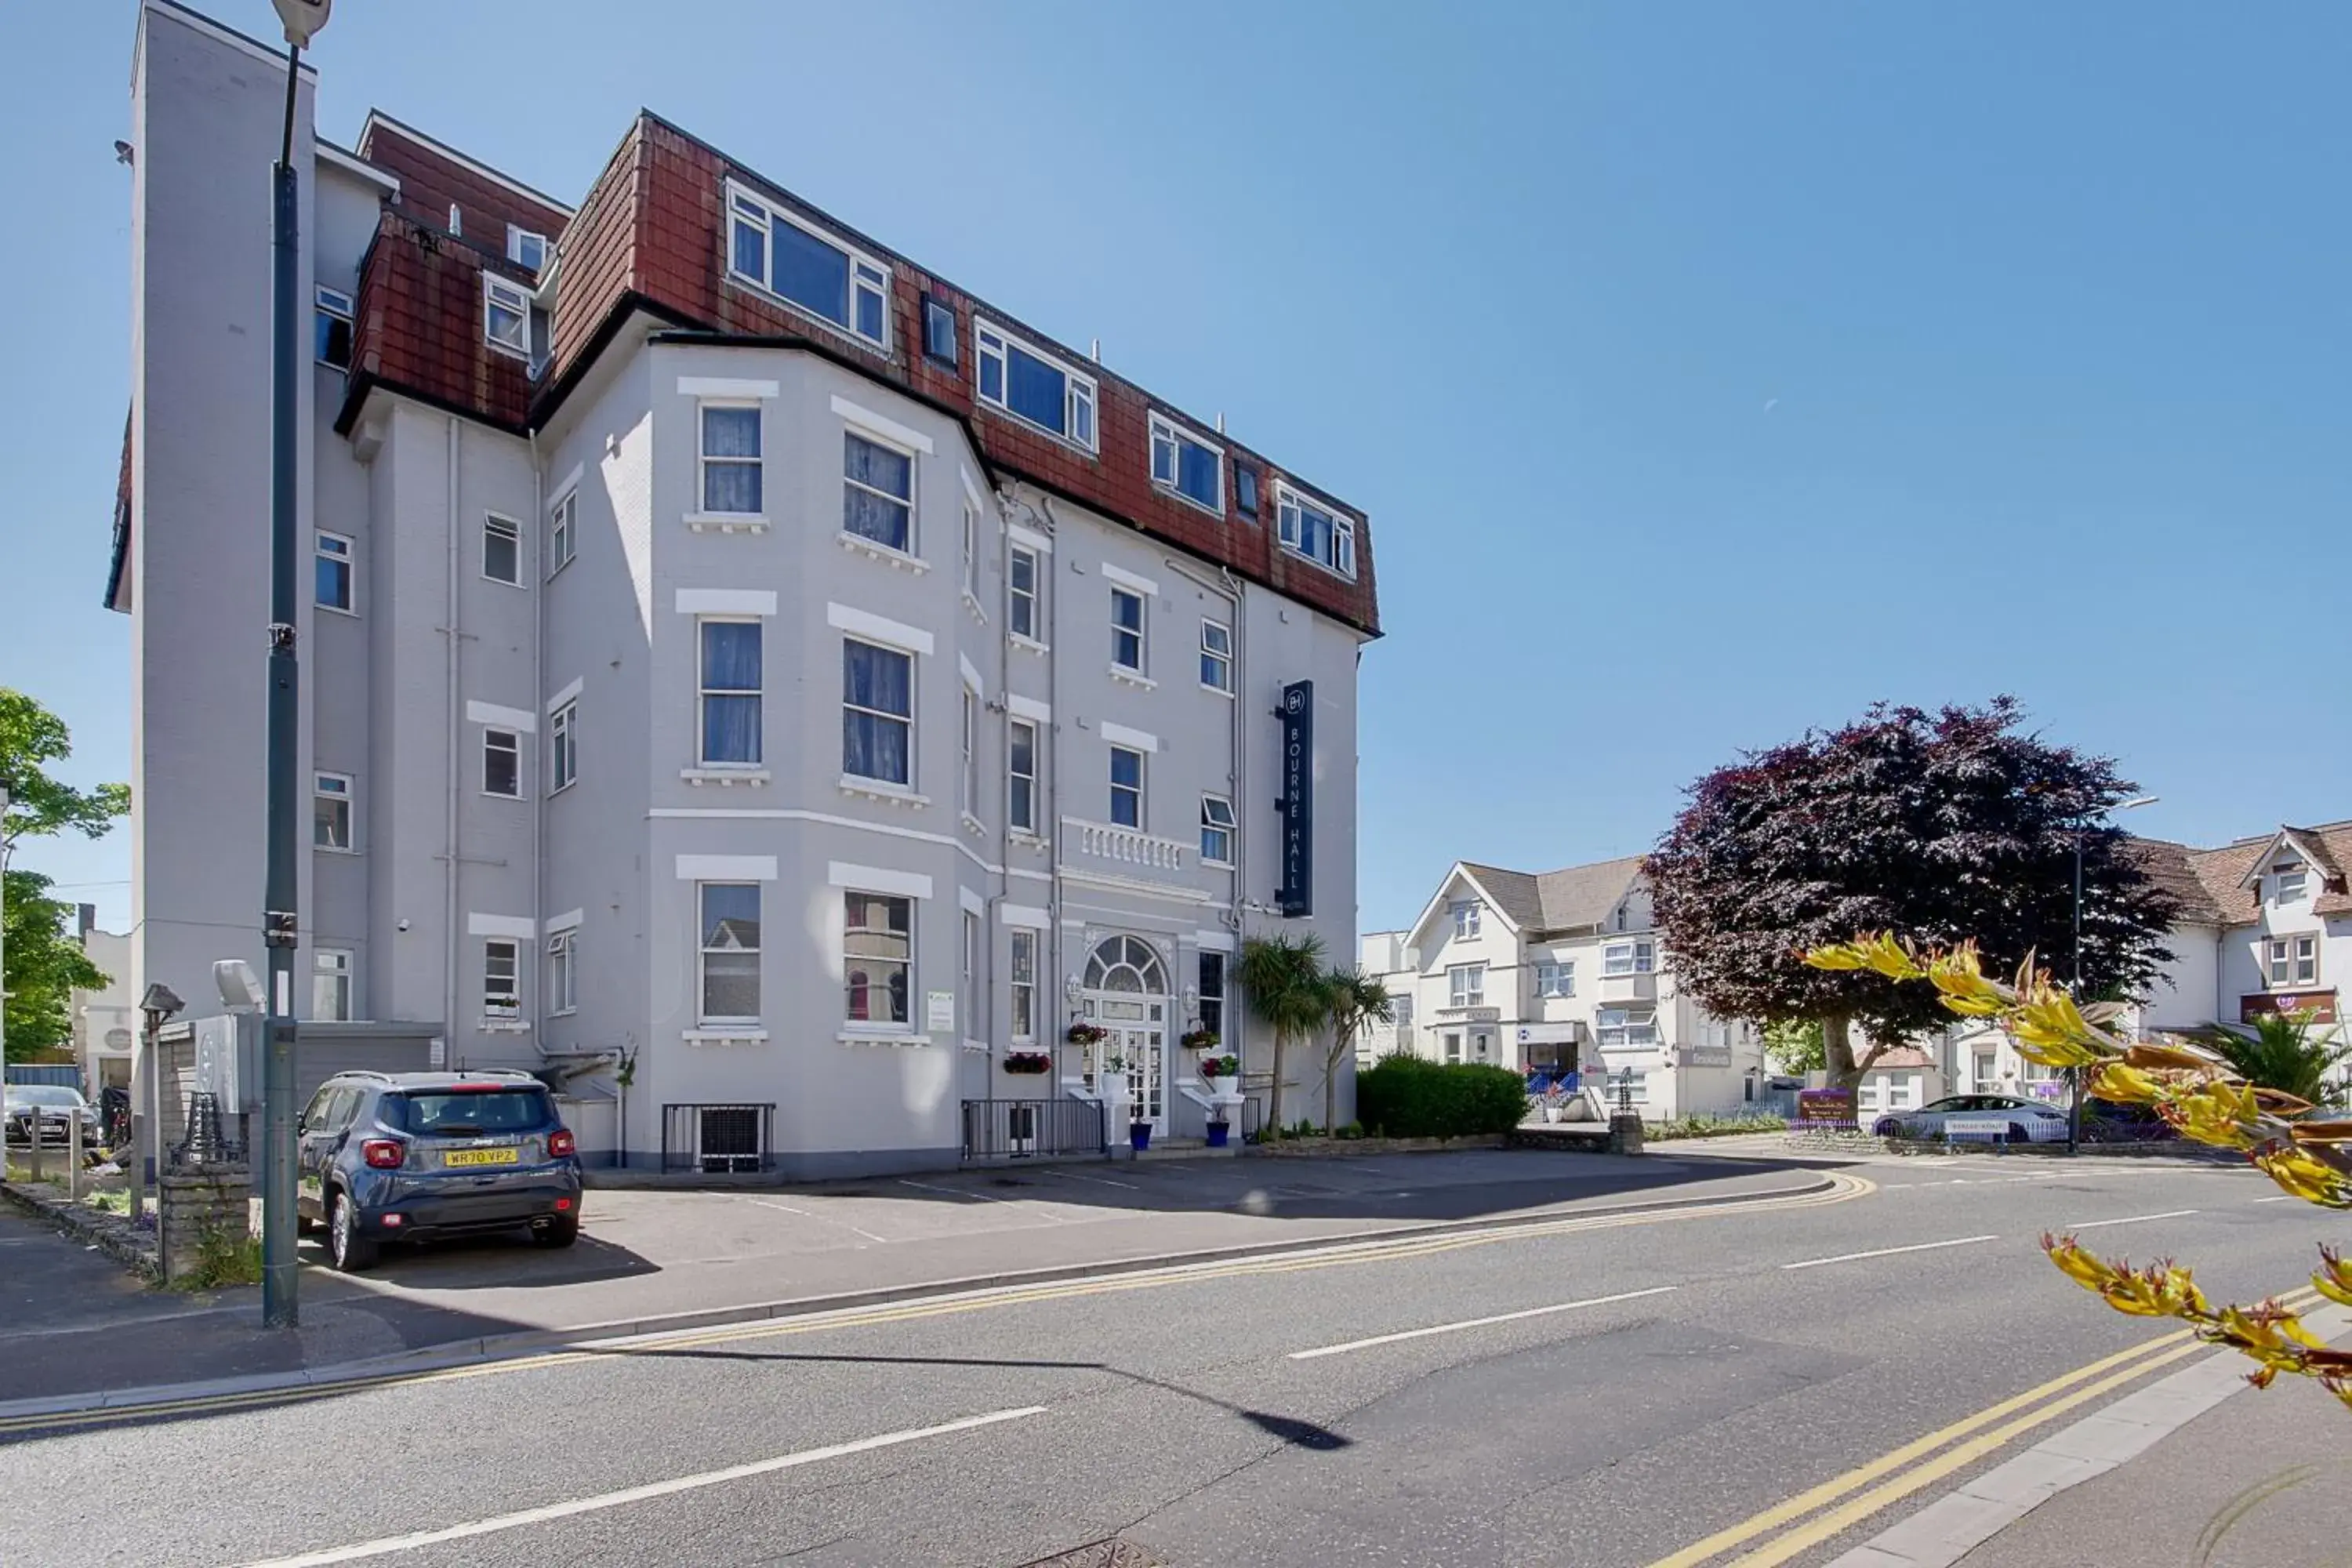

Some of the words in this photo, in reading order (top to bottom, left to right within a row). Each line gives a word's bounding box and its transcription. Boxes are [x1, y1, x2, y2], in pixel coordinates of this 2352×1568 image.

[1290, 728, 1301, 818] BOURNE
[1290, 829, 1299, 888] HALL
[488, 1150, 512, 1161] VPZ
